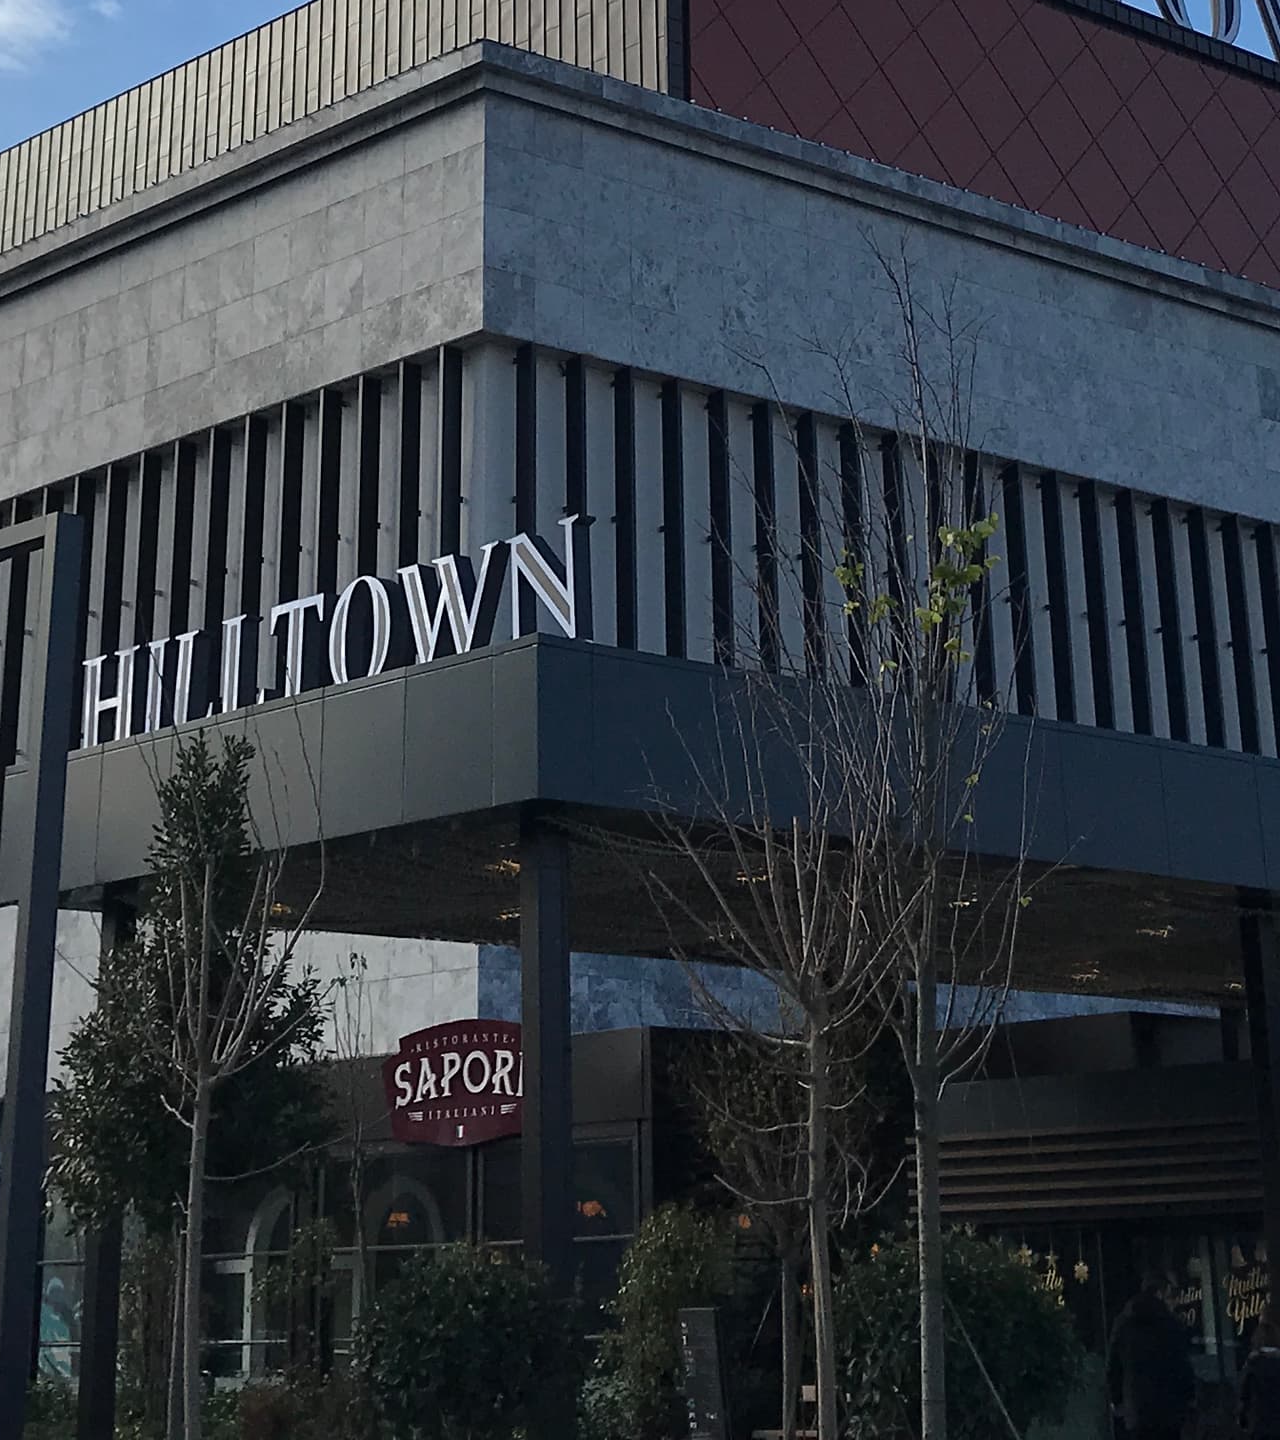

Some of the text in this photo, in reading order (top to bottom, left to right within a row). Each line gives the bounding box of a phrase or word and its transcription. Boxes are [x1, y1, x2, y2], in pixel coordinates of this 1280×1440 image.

[82, 513, 580, 748] HILLTOWN
[416, 1032, 509, 1052] RISTORANTE
[394, 1049, 523, 1109] SAPORI
[427, 1105, 496, 1121] ITALIANI
